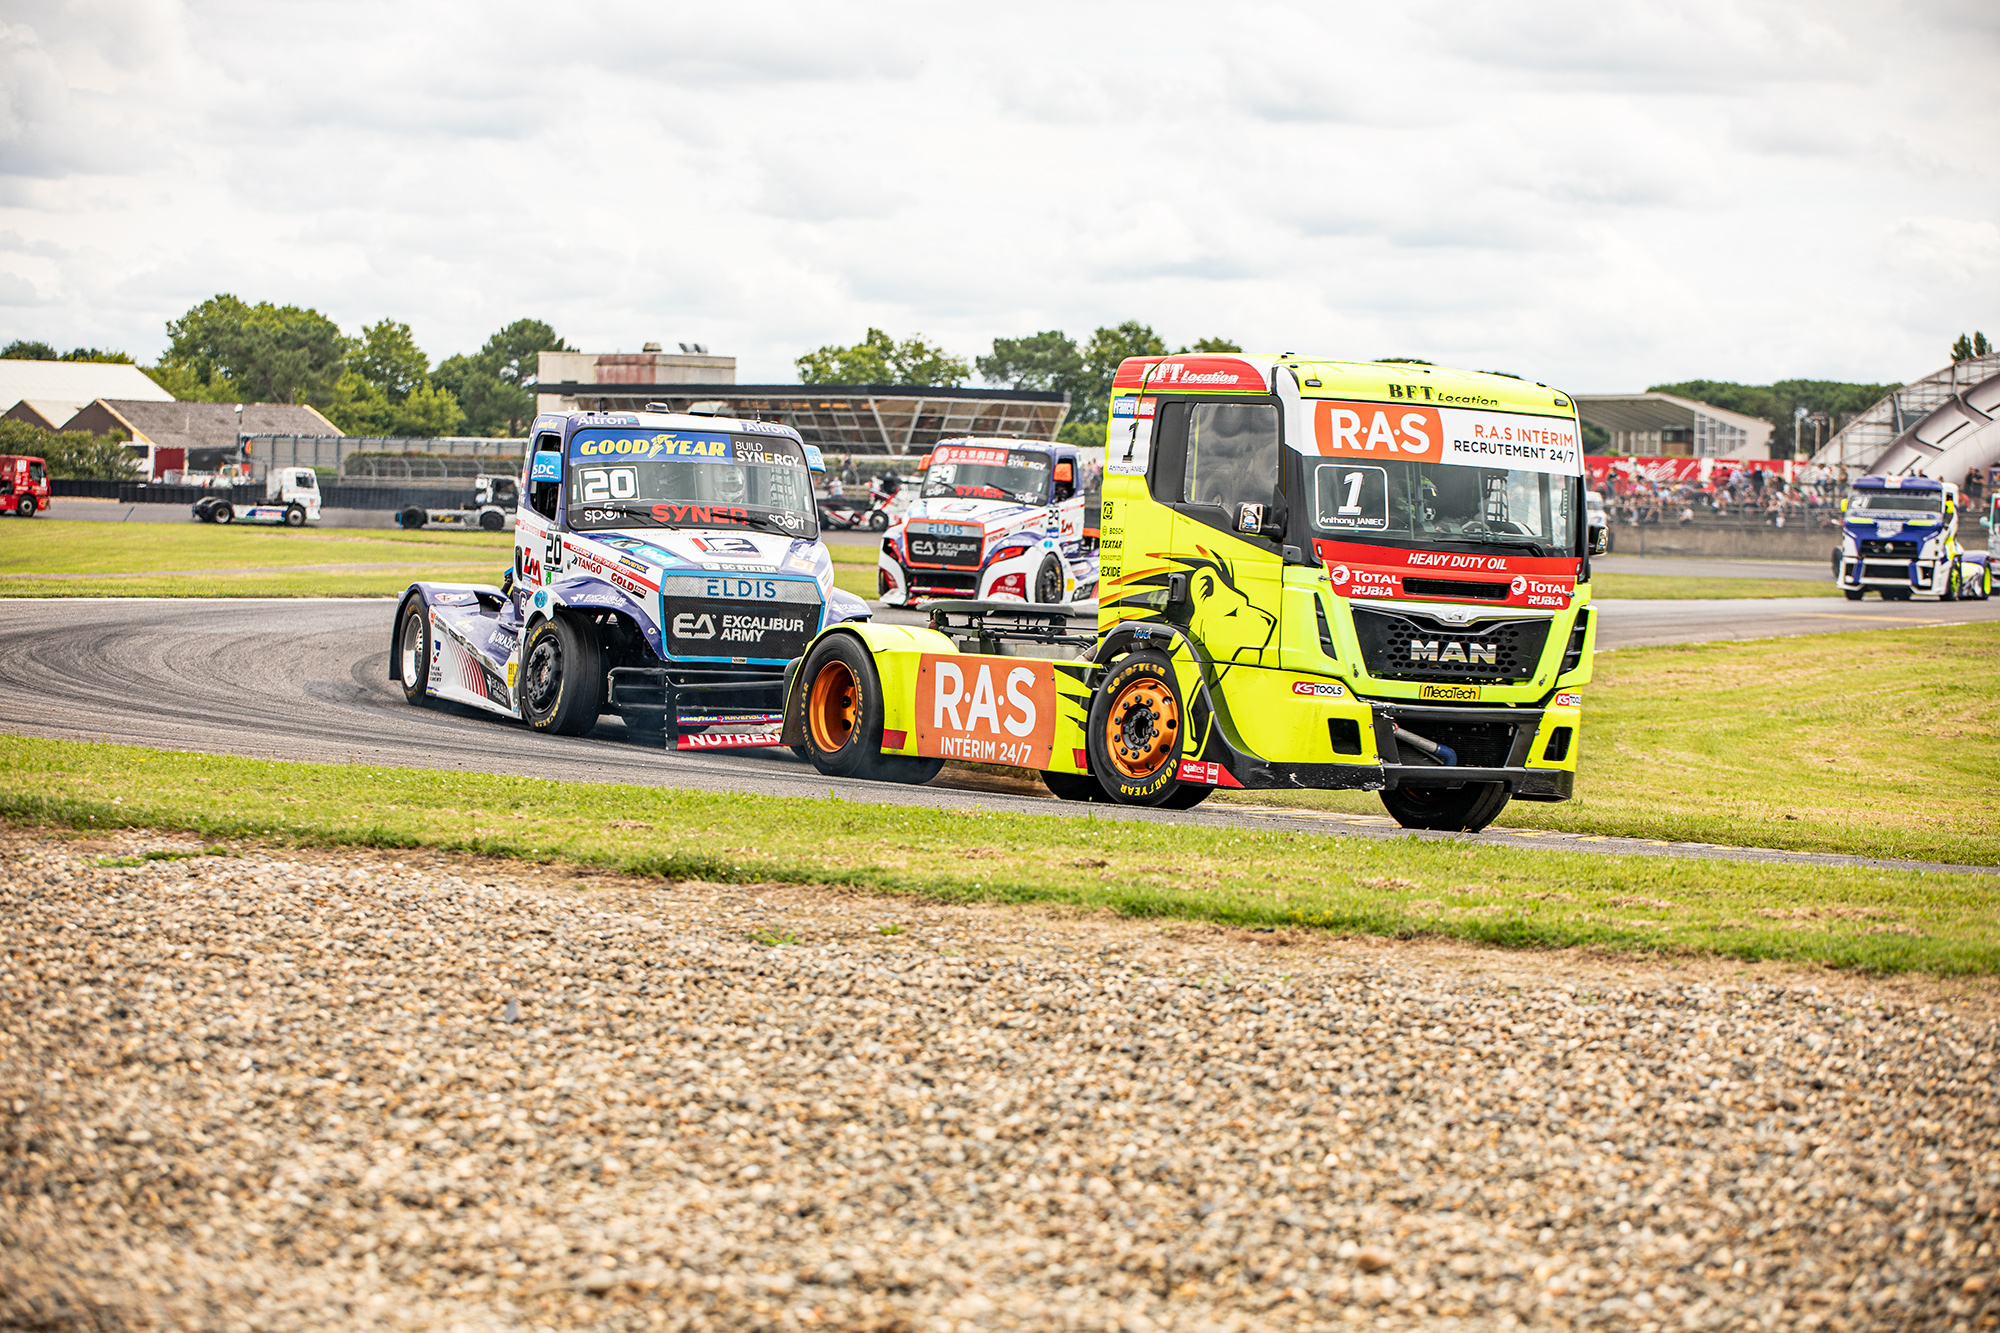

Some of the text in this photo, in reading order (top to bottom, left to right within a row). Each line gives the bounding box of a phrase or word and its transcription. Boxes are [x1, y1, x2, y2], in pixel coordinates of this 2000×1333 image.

[1139, 363, 1240, 384] BFT Location
[1388, 384, 1499, 407] BFT Location
[577, 415, 627, 426] Altron
[745, 422, 790, 435] Altron
[1474, 424, 1574, 448] R.A.S INTÉRIM
[735, 441, 763, 452] BUILD
[1454, 439, 1575, 464] RECRUTEMENT 24/7
[533, 464, 555, 475] SDC
[583, 469, 636, 501] 20
[1337, 471, 1364, 516] 1
[928, 523, 963, 535] ELDIS
[1320, 517, 1355, 526] Anthony
[545, 532, 562, 565] 20
[1101, 540, 1122, 549] TEXTAR
[577, 556, 602, 575] TANGO
[1406, 552, 1508, 570] HEAVY DUTY OIL
[610, 572, 635, 591] GOLD
[707, 579, 777, 598] ELDIS
[722, 615, 805, 632] EXCALIBUR
[720, 628, 766, 643] ARMY
[1410, 639, 1498, 665] MAN
[1314, 684, 1343, 695] TOOLS
[940, 733, 1032, 765] INTÉRIM 24/7
